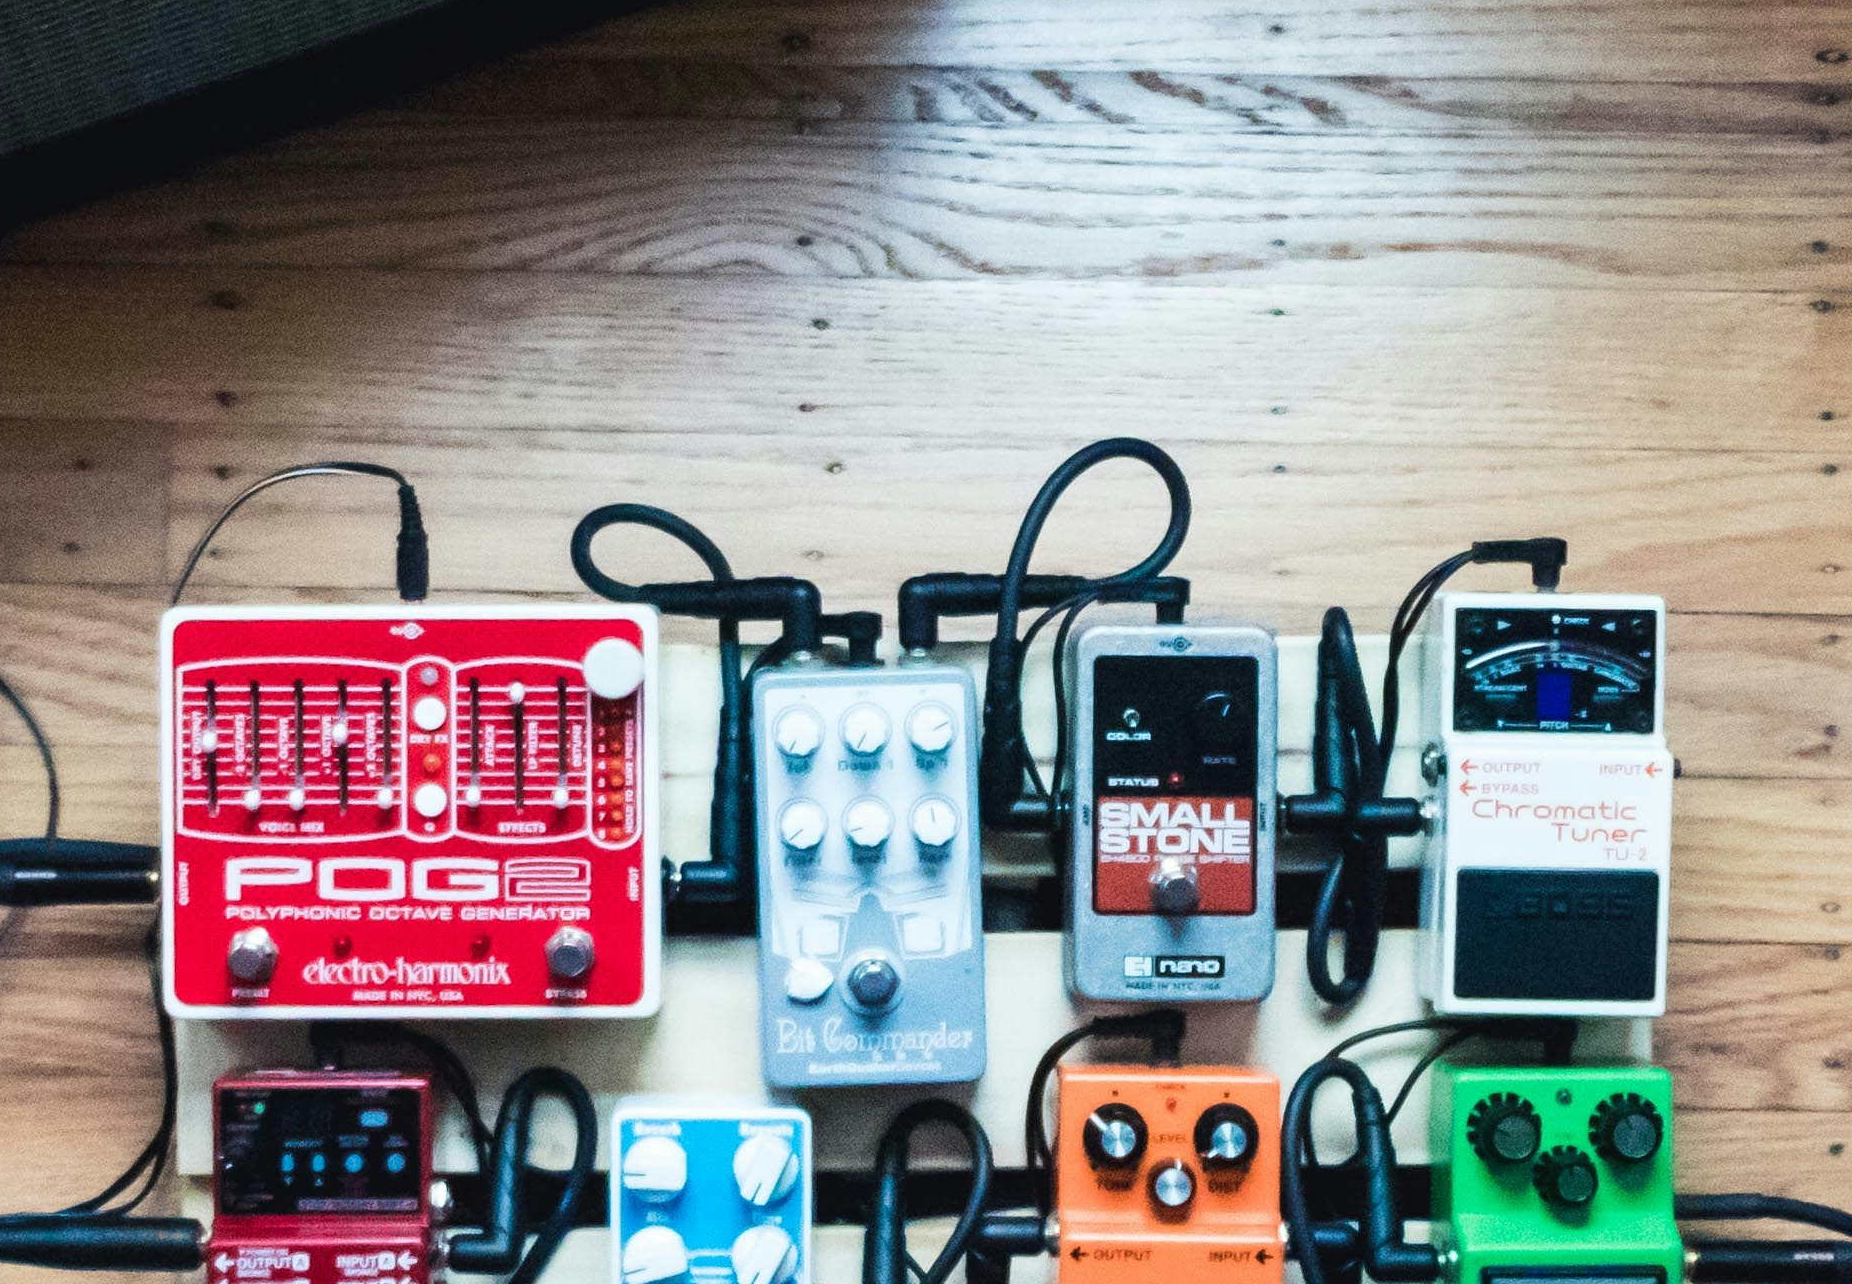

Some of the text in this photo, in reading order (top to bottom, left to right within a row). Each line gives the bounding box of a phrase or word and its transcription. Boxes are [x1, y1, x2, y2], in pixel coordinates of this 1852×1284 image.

[1106, 731, 1152, 741] COLOR
[1202, 755, 1236, 765] RATE
[1482, 762, 1541, 774] OUTPUT
[1599, 764, 1644, 776] INPUT
[1108, 777, 1160, 787] STATUS
[1481, 782, 1540, 795] BYPASS
[1099, 802, 1251, 828] SMALL
[1472, 799, 1637, 821] Chromatic
[1551, 822, 1648, 843] Tuner
[1099, 827, 1251, 854] STONE
[1604, 847, 1647, 861] TU-2
[225, 856, 591, 902] POG2
[226, 904, 591, 921] POLYPHONIC OCTAVE GENERATOR
[302, 956, 512, 986] electro-harmonix
[1159, 959, 1221, 974] nano
[352, 990, 387, 1002] MADE
[390, 990, 404, 1001] IN
[439, 990, 464, 1002] USA
[776, 1017, 974, 1061] Bit Commander
[1152, 1135, 1186, 1143] LEVEL
[236, 1256, 292, 1269] OUTPUT
[336, 1256, 378, 1269] INPUT
[1093, 1250, 1152, 1262] OUTPUT
[1208, 1251, 1252, 1263] INPUT
